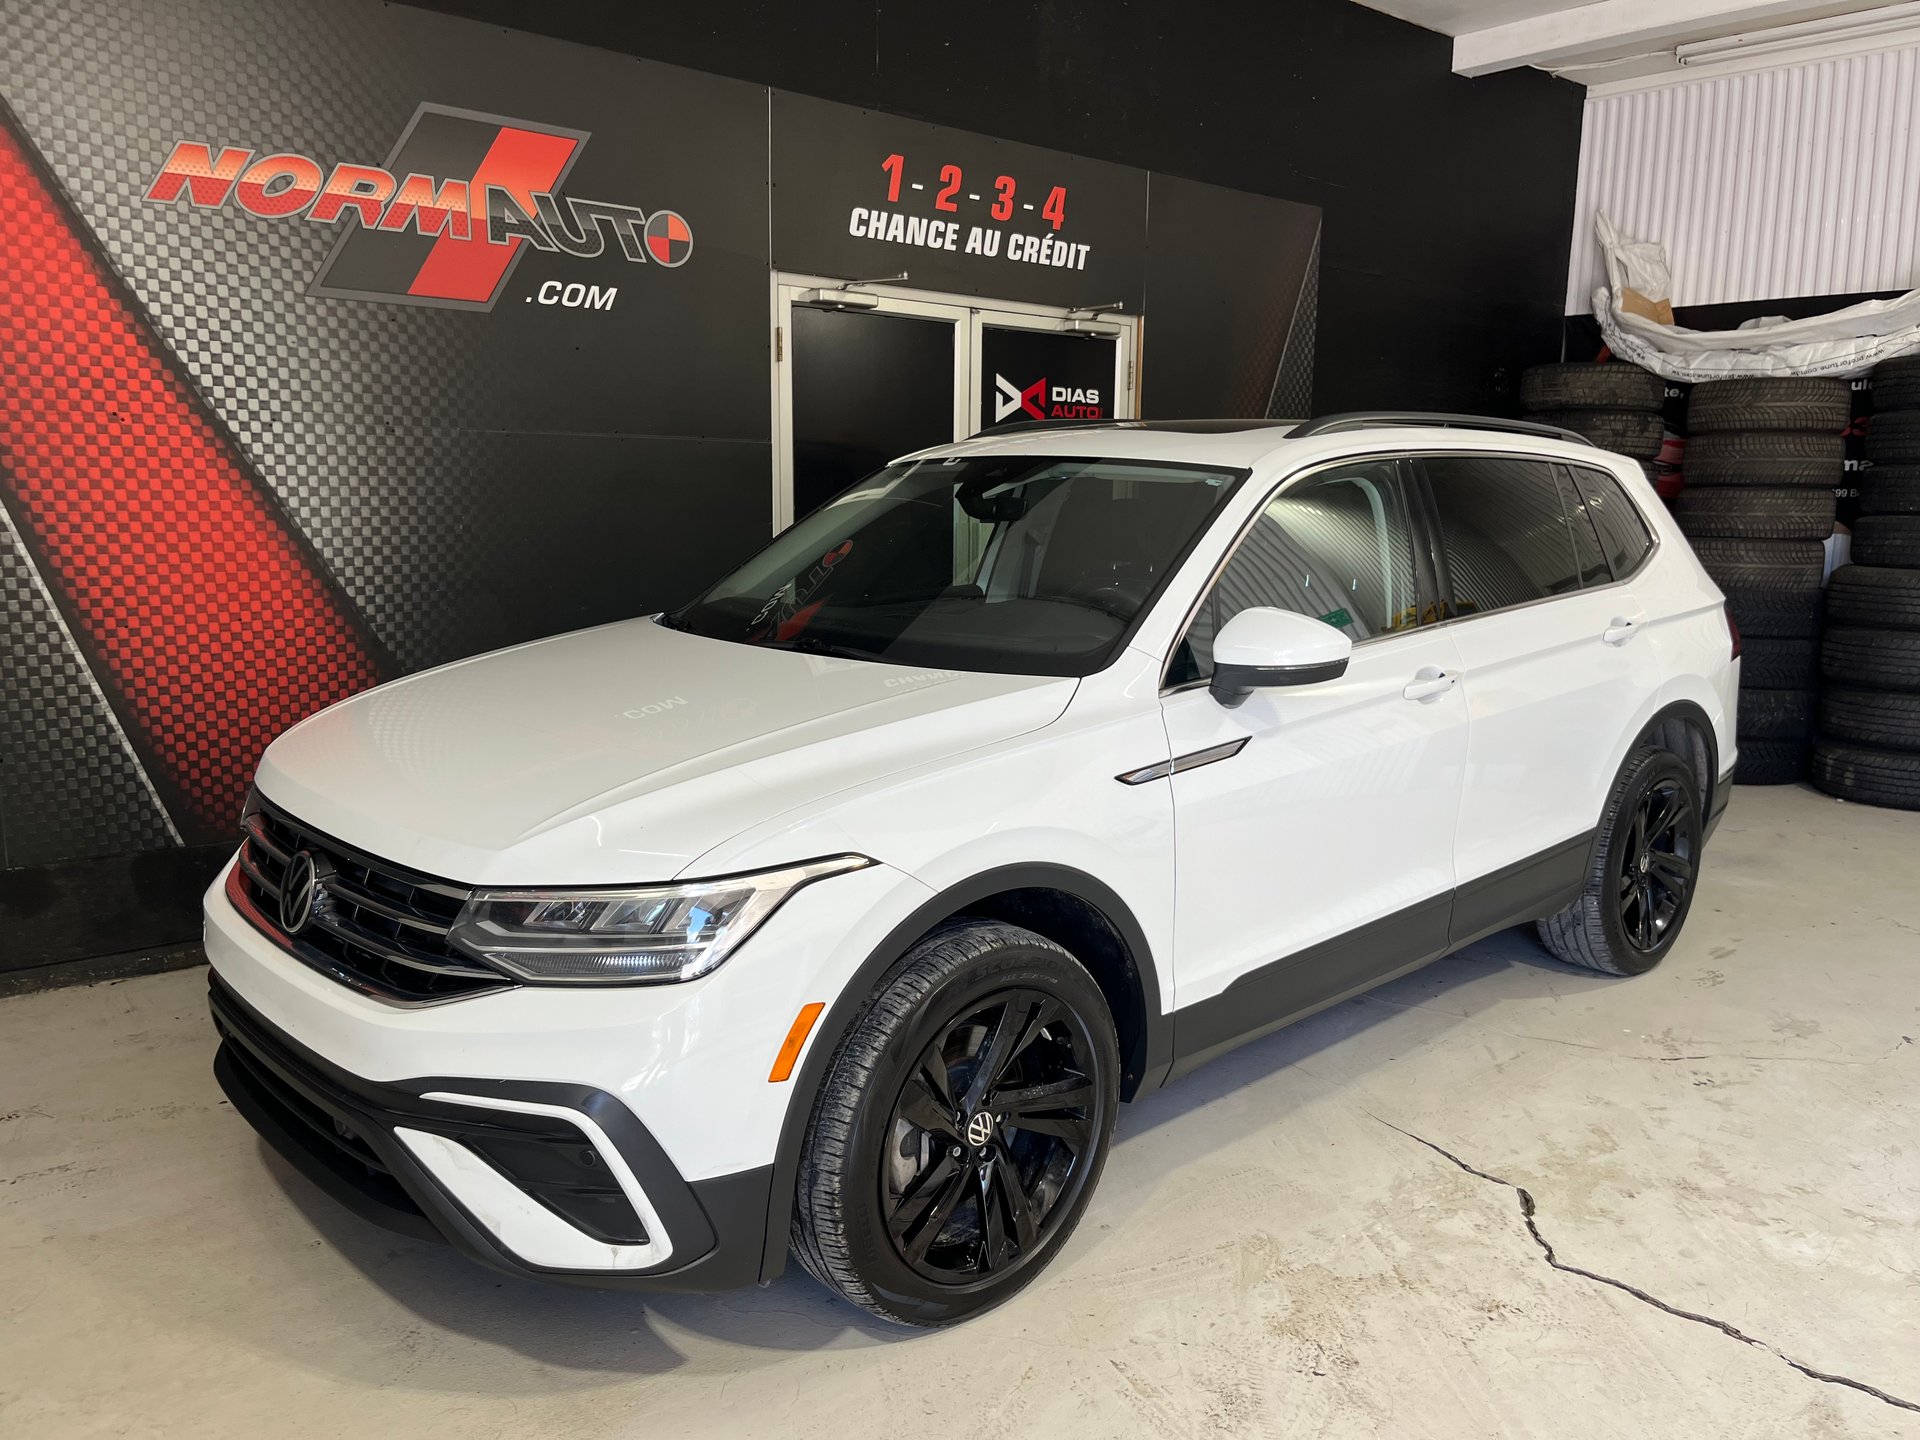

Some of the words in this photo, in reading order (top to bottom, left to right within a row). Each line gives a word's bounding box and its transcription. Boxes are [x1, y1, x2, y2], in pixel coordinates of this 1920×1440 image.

[849, 207, 959, 251] CHANCE
[965, 226, 1001, 257] AU
[1007, 233, 1090, 270] CRÉDIT
[525, 280, 617, 311] .COM
[1052, 387, 1099, 404] DIAS
[1051, 404, 1099, 419] AUTO
